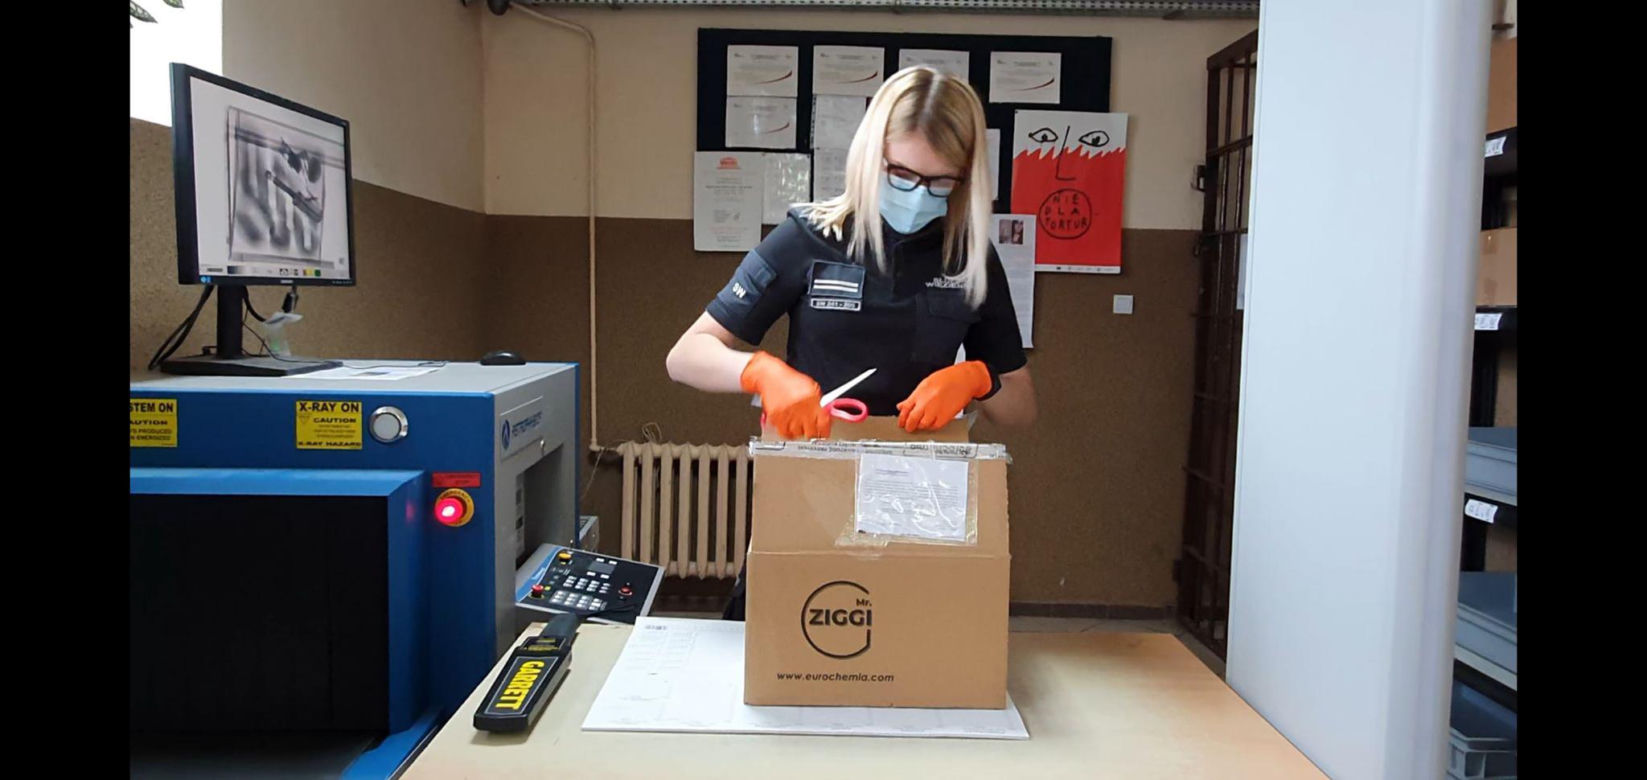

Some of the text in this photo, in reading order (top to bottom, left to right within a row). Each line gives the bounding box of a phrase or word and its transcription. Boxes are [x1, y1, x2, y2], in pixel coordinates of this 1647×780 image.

[1053, 193, 1080, 205] NIE
[1044, 206, 1080, 216] DLA
[1045, 216, 1088, 231] TORTUR
[732, 282, 747, 299] SW
[158, 402, 174, 413] ON
[299, 402, 359, 412] X-RAY ON
[856, 598, 872, 607] Mr.
[809, 608, 872, 627] ZIGGI
[494, 660, 545, 711] GARRETT
